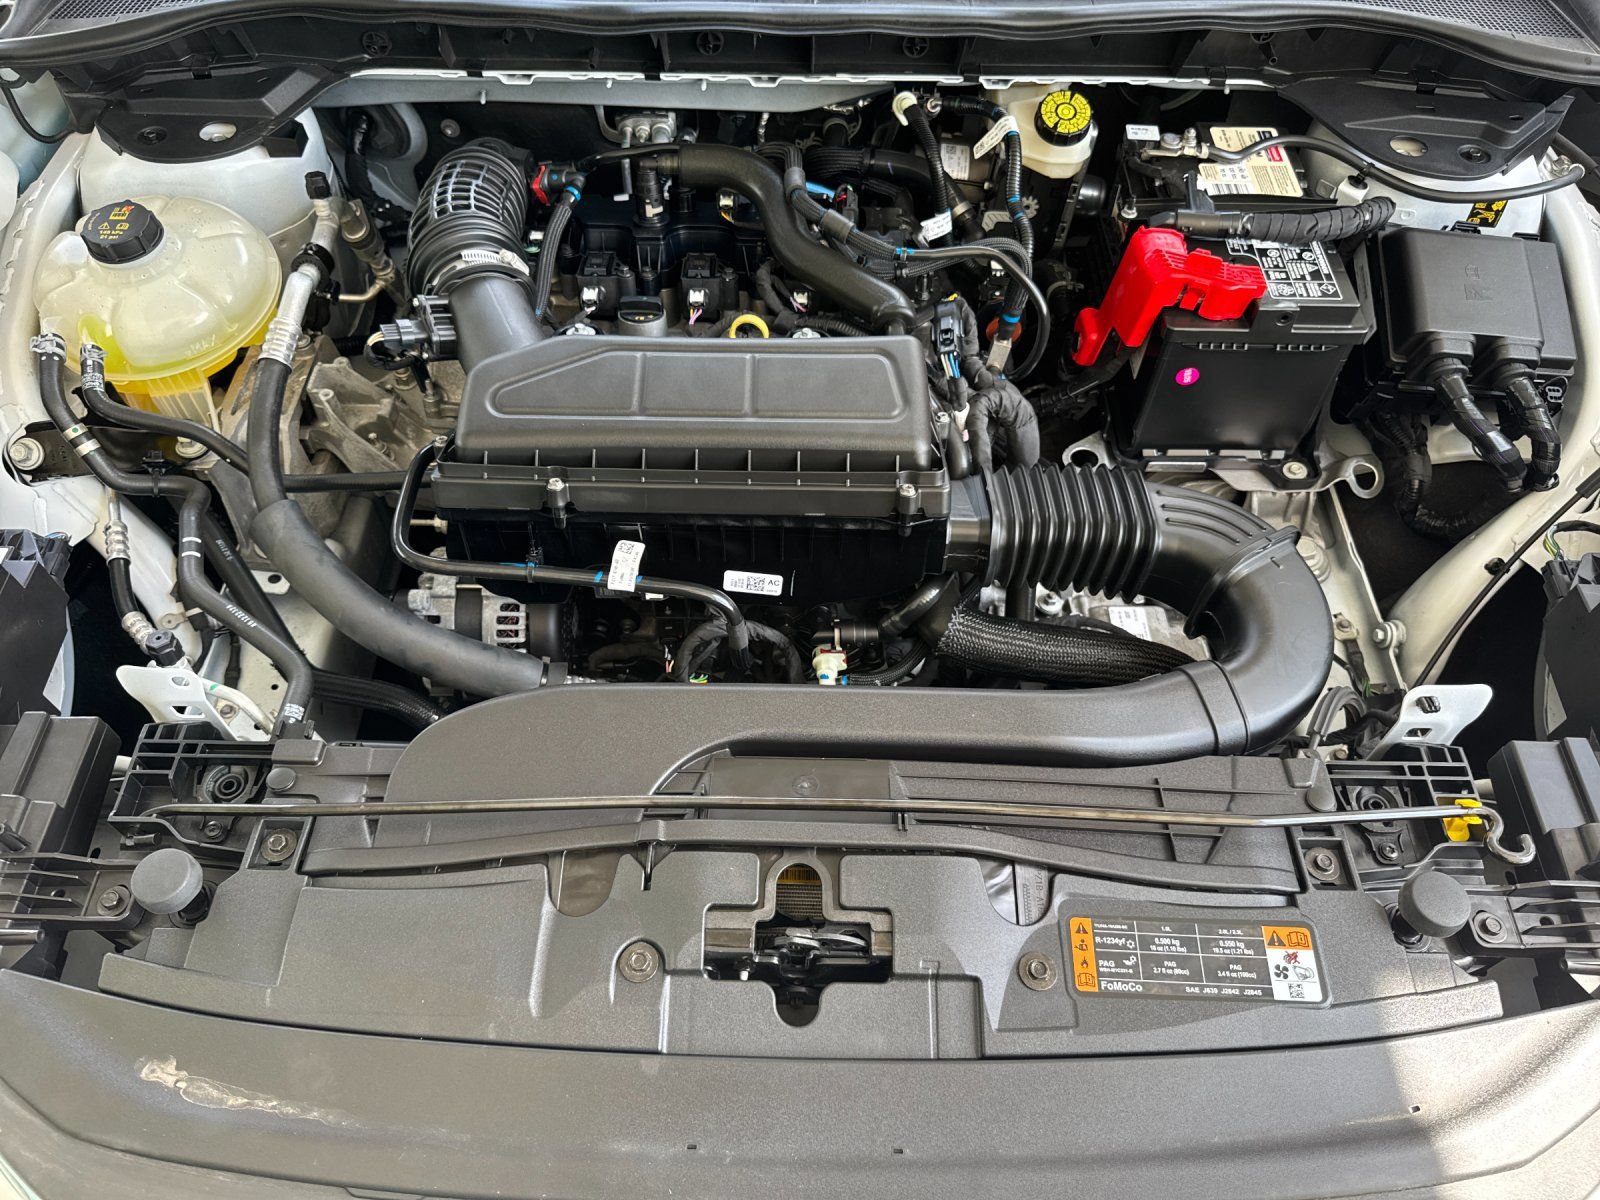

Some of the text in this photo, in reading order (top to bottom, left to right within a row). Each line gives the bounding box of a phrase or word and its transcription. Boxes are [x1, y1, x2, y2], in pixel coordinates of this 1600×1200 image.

[1095, 936, 1126, 946] R-1234yf
[1171, 938, 1180, 946] kg
[1236, 941, 1245, 949] kg
[1100, 981, 1143, 992] FoMoCo
